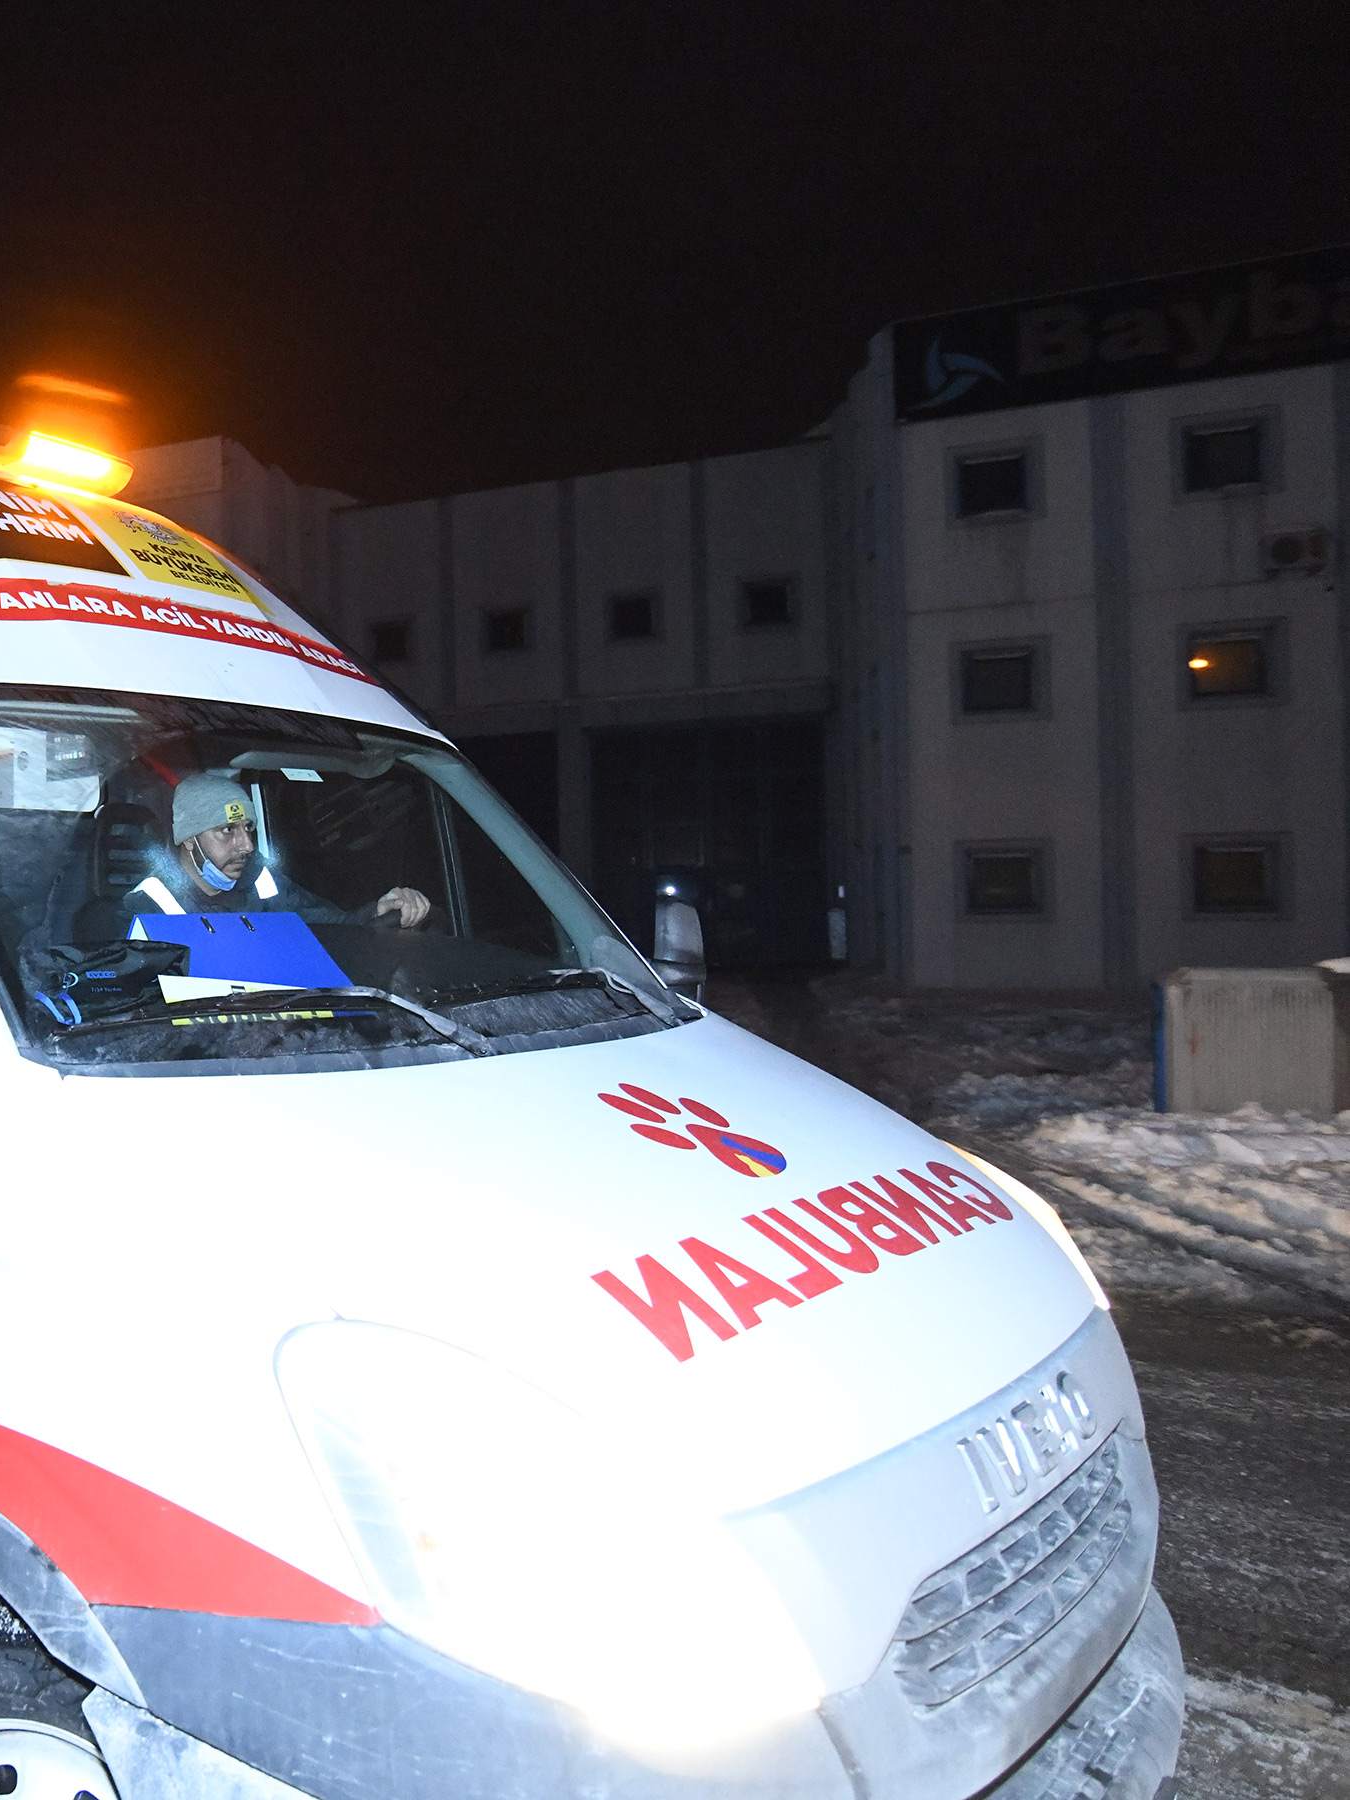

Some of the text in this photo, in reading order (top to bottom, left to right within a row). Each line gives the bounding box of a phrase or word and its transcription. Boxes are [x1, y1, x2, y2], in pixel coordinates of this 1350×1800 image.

[148, 542, 209, 566] KONYA
[140, 604, 207, 630] ACİL
[205, 617, 300, 653] YARDIM
[956, 1370, 1097, 1513] IVECO
